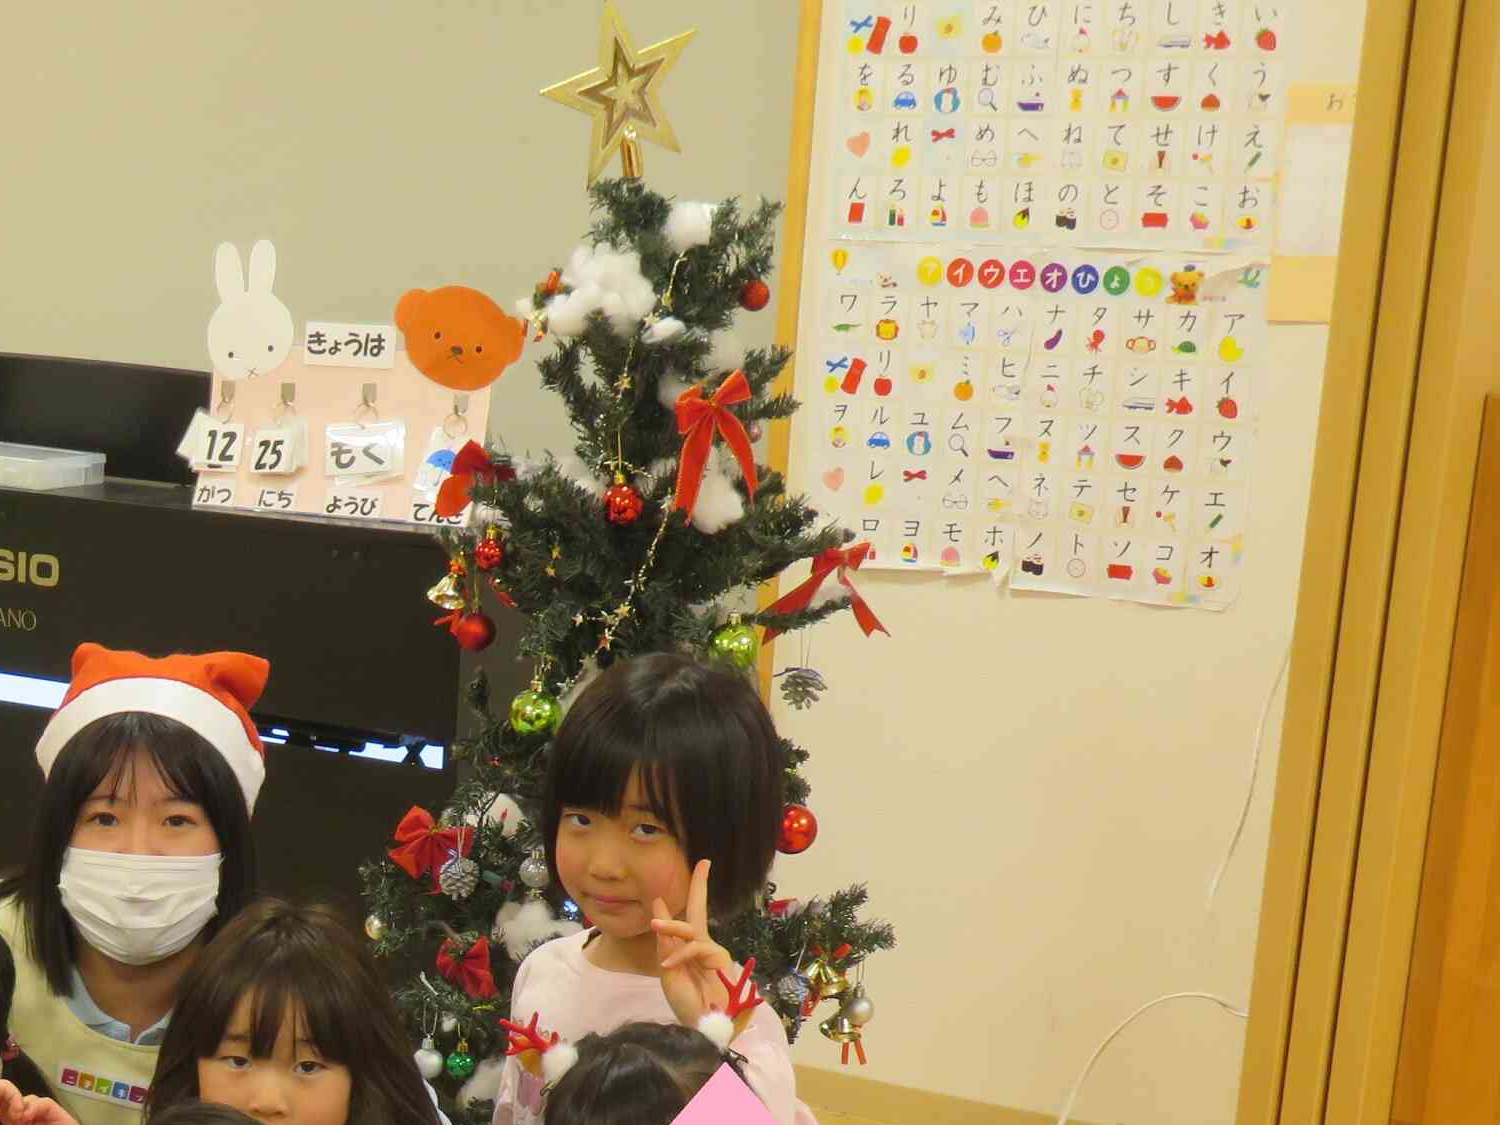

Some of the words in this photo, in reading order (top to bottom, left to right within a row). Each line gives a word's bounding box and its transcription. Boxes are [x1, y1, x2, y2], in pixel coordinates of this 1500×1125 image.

[903, 5, 915, 27] り
[983, 6, 1002, 25] み
[1029, 6, 1047, 26] ひ
[1074, 6, 1092, 24] に
[1119, 2, 1135, 26] ち
[1166, 2, 1180, 25] し
[1212, 2, 1226, 25] き
[1255, 9, 1277, 21] い
[859, 64, 872, 85] を
[898, 64, 914, 85] る
[940, 65, 957, 84] ゆ
[983, 64, 1000, 85] む
[1022, 66, 1043, 84] ふ
[1068, 65, 1088, 84] ぬ
[1111, 67, 1131, 81] つ
[1156, 63, 1180, 84] す
[1209, 63, 1219, 85] く
[1254, 63, 1267, 86] う
[892, 122, 912, 142] れ
[977, 124, 995, 142] め
[1018, 128, 1039, 140] へ
[1063, 123, 1082, 144] ね
[1107, 124, 1126, 145] て
[1151, 126, 1173, 147] せ
[1198, 125, 1219, 145] け
[1244, 125, 1262, 148] え
[848, 178, 867, 199] ん
[889, 179, 906, 200] ろ
[932, 179, 948, 201] よ
[976, 180, 988, 203] も
[1015, 182, 1034, 203] ほ
[1059, 184, 1078, 201] の
[1104, 184, 1119, 204] と
[1147, 185, 1167, 206] そ
[1195, 186, 1208, 206] こ
[1239, 185, 1259, 208] お
[840, 294, 857, 312] ワ
[881, 296, 897, 314] ラ
[921, 296, 938, 318] ヤ
[961, 302, 979, 317] マ
[1001, 306, 1022, 316] ハ
[1047, 305, 1066, 324] ナ
[1092, 307, 1107, 326] タ
[1133, 309, 1154, 328] サ
[1180, 311, 1196, 332] カ
[1224, 314, 1244, 333] ア
[307, 331, 385, 357] きょうは
[879, 350, 891, 372] リ
[963, 357, 969, 375] ミ
[1002, 357, 1015, 377] ヒ
[1041, 365, 1059, 378] ニ
[1083, 365, 1103, 385] チ
[1172, 369, 1191, 391] キ
[1220, 372, 1234, 393] イ
[834, 405, 847, 422] ヲ
[872, 406, 890, 425] ル
[911, 412, 929, 425] ユ
[952, 413, 969, 430] ム
[995, 417, 1012, 433] フ
[1124, 426, 1140, 445] ス
[1168, 429, 1184, 448] ク
[1213, 431, 1232, 451] ウ
[207, 430, 237, 461] 12
[255, 440, 284, 470] 25
[331, 441, 385, 468] もく
[870, 461, 885, 480] レ
[948, 469, 964, 486] メ
[1034, 473, 1049, 497] ネ
[1073, 480, 1092, 497] テ
[1117, 482, 1137, 502] セ
[1163, 484, 1180, 504] ケ
[1205, 492, 1225, 506] エ
[197, 486, 231, 503] がつ
[259, 490, 294, 508] にち
[326, 496, 378, 515] ようび
[413, 503, 462, 525] てん
[863, 519, 879, 531] ロ
[904, 521, 919, 537] ヨ
[943, 523, 962, 542] モ
[984, 527, 1004, 546] ホ
[1028, 533, 1042, 548] ノ
[1074, 535, 1084, 555] ト
[1114, 541, 1130, 556] ソ
[1156, 546, 1173, 560] コ
[1201, 546, 1219, 568] オ
